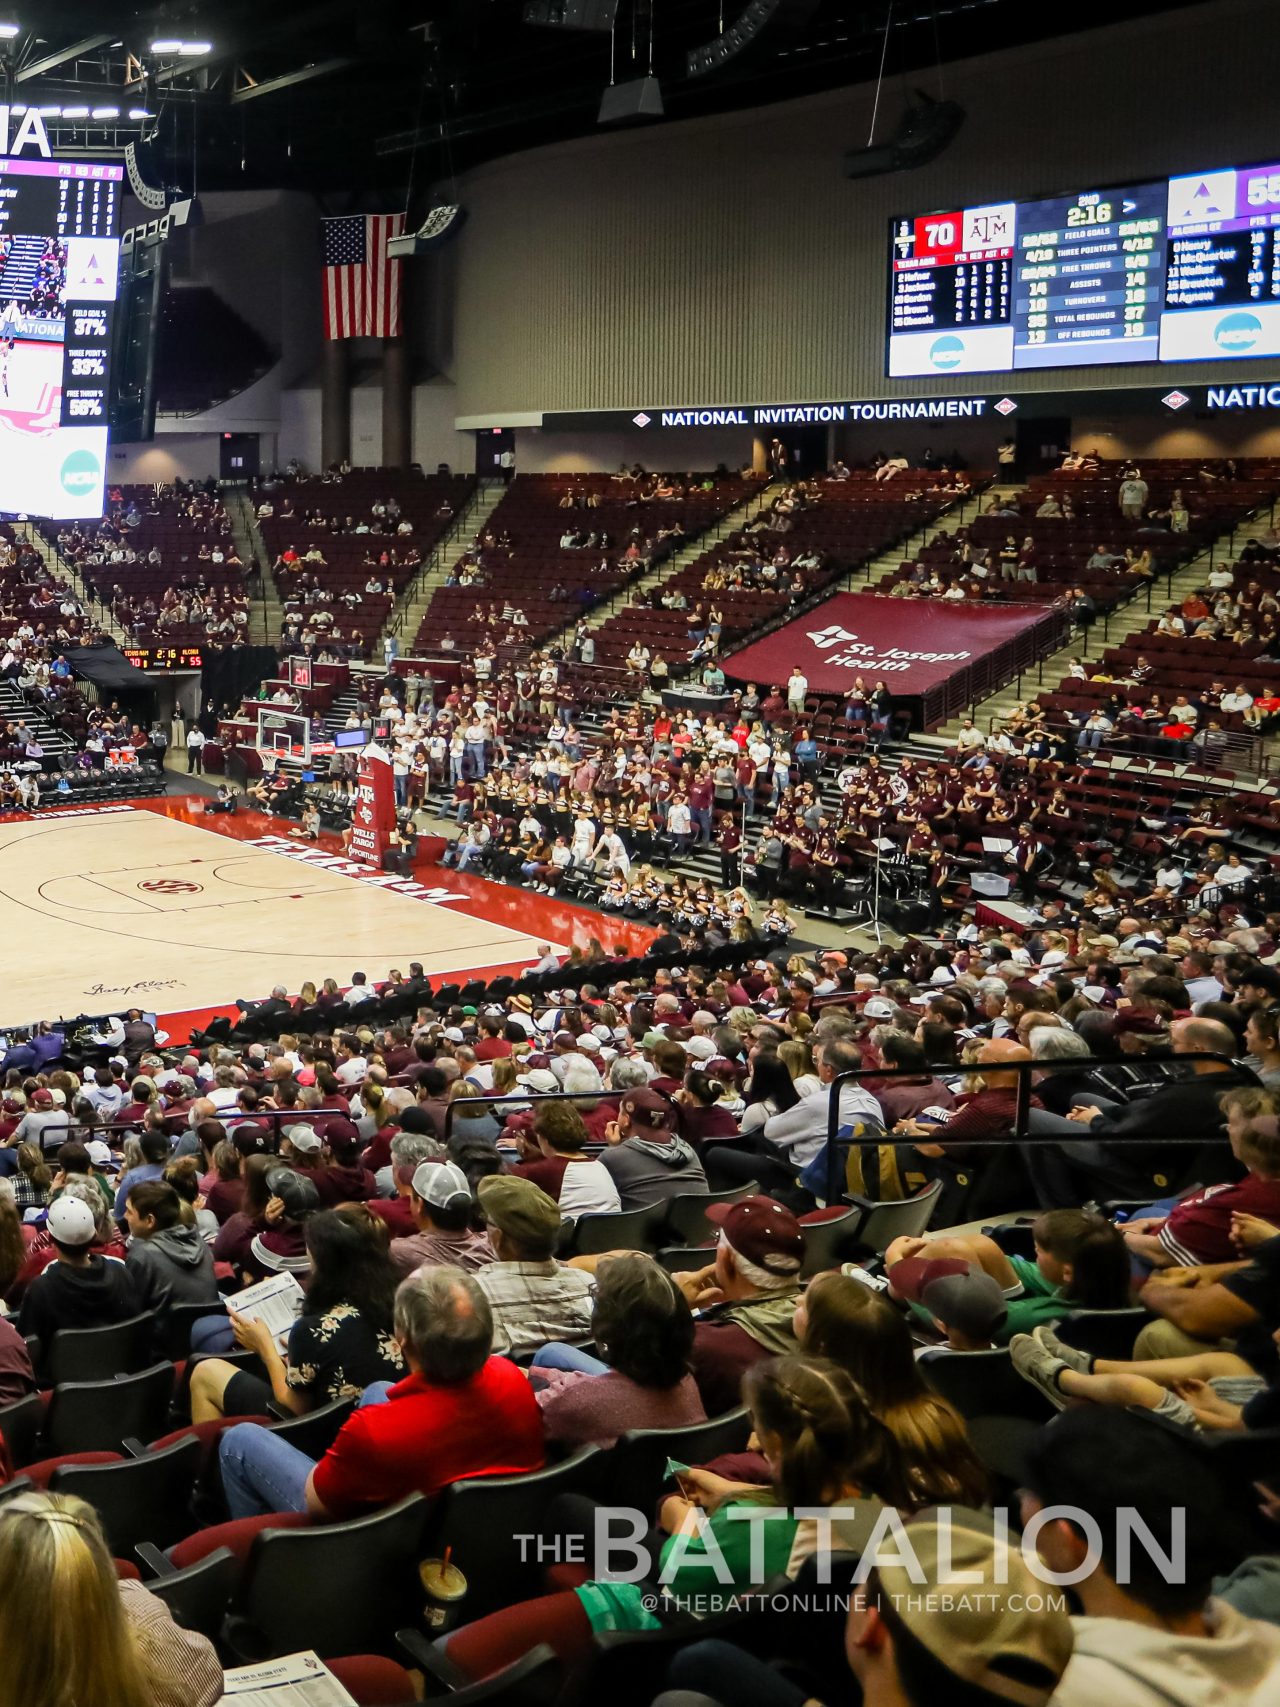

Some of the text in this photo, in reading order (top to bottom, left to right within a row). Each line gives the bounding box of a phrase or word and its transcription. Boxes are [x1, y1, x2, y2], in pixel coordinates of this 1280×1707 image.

[1067, 203, 1112, 227] 2:16
[925, 222, 954, 248] 70
[1065, 228, 1110, 240] FIELD GOALS
[1057, 247, 1080, 257] THREE
[1081, 243, 1118, 255] POINTERS
[1062, 261, 1112, 273] FREE THROWS
[1029, 272, 1146, 296] 14 ASSISTS 14
[1065, 295, 1106, 306] TURNOVERS
[1055, 314, 1076, 323] TOTAL
[1076, 311, 1116, 322] REBOUNDS
[1072, 328, 1111, 339] REBOUNDS
[661, 399, 986, 426] NATIONAL INVITATION TOURNAMENT
[843, 643, 971, 663] St. Joseph
[189, 656, 202, 666] 55
[824, 654, 911, 671] Health
[294, 668, 308, 685] 20
[353, 827, 376, 840] WELLS
[353, 836, 375, 849] FARGO
[242, 834, 471, 904] TEXAS A&M
[142, 879, 198, 894] SEC
